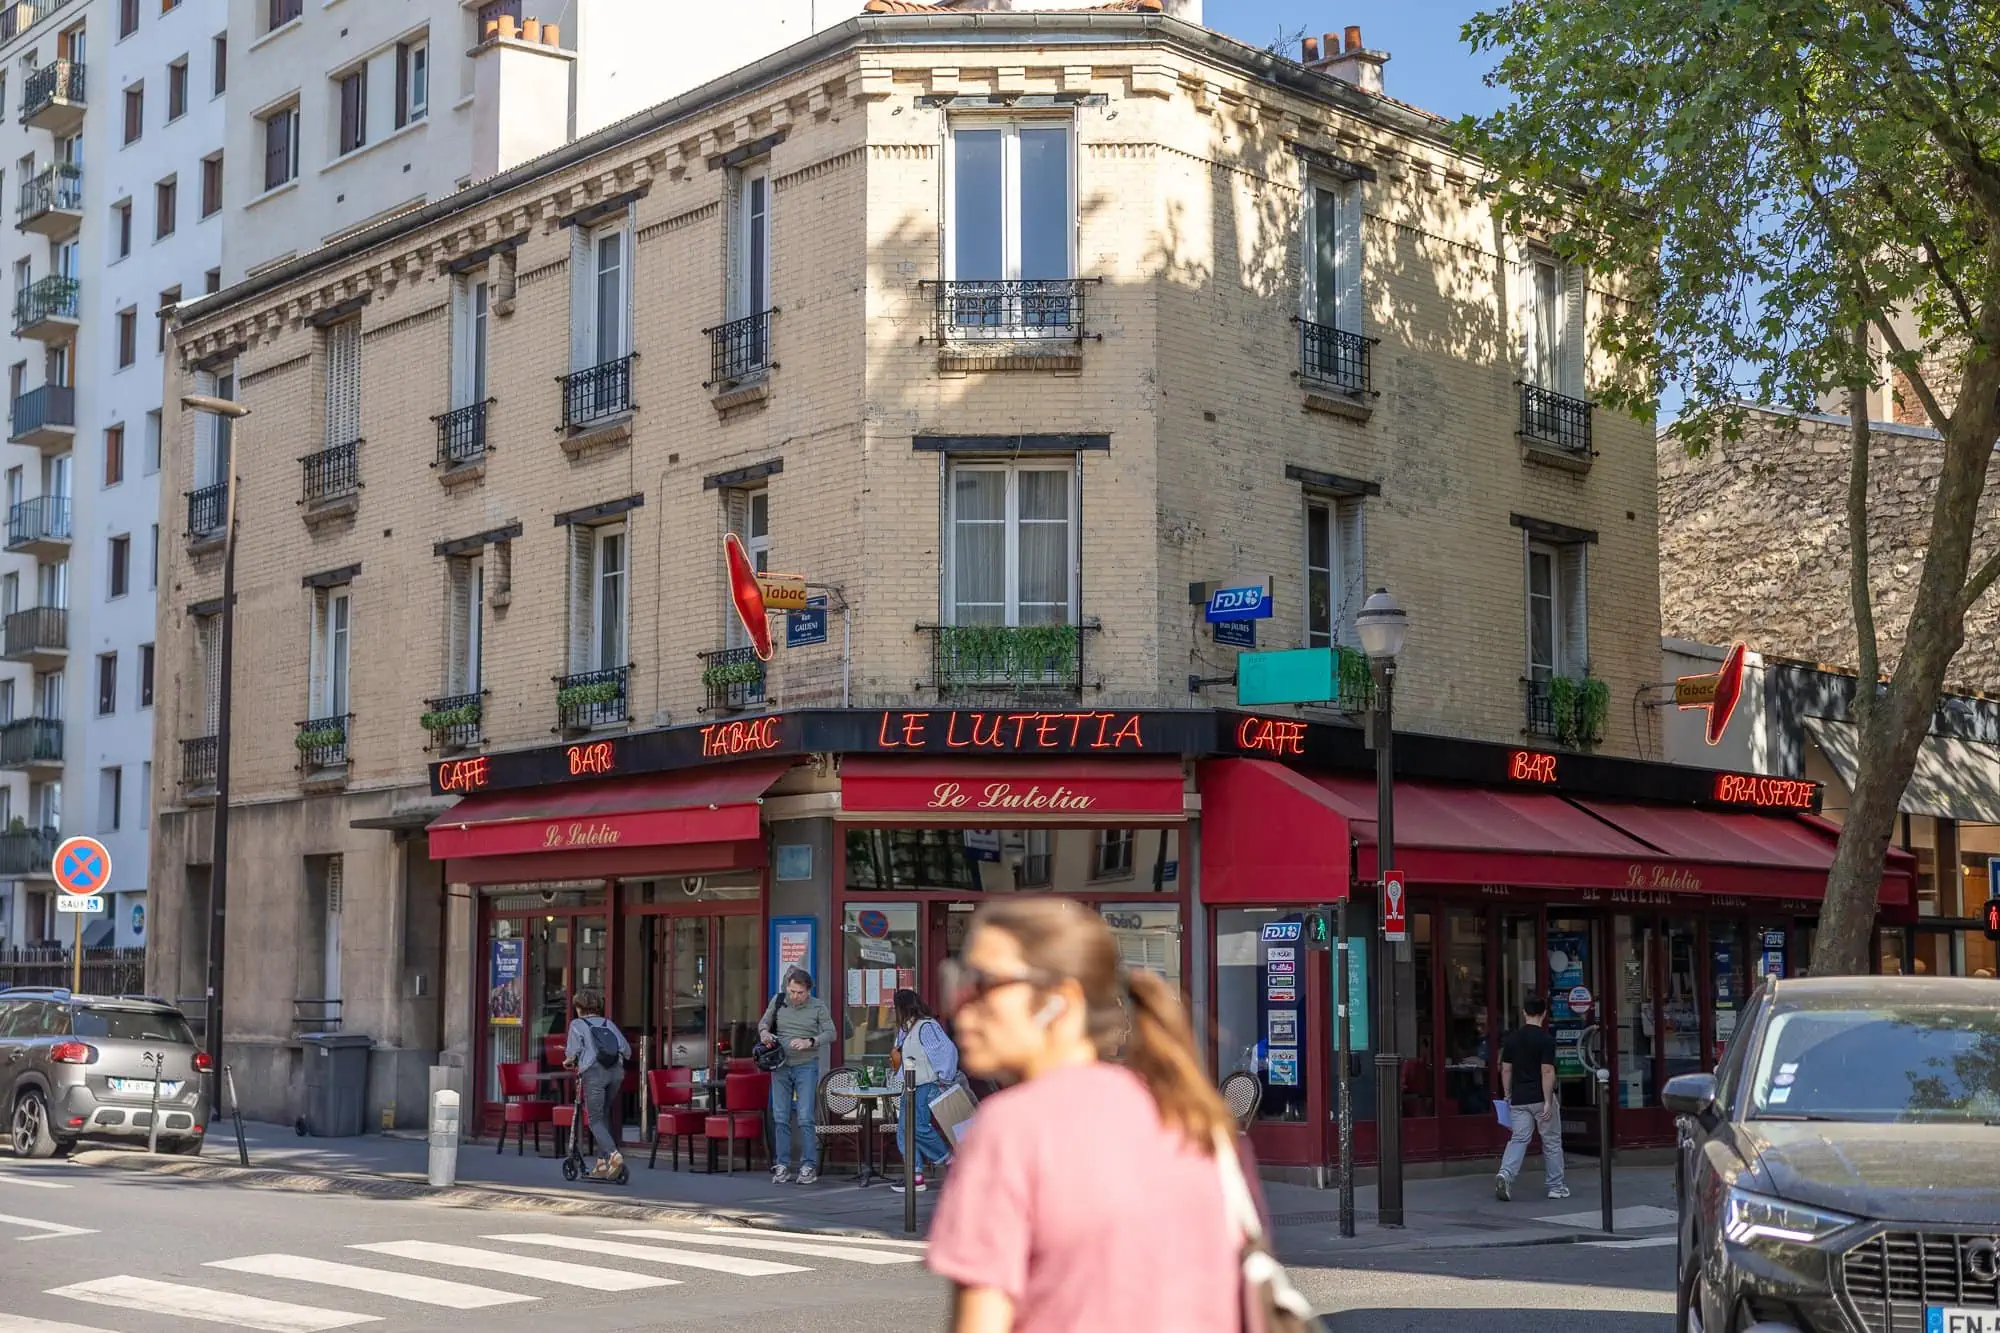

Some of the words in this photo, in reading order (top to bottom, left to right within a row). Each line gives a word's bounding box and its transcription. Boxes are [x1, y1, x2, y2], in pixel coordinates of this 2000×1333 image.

[763, 584, 805, 600] Tabac
[1214, 591, 1243, 608] FDJ
[1678, 684, 1714, 696] Tabac
[700, 716, 780, 756] TABAC
[879, 712, 929, 747] LE
[948, 711, 1143, 748] LUTETIA
[1241, 717, 1308, 755] CAFE
[567, 742, 614, 775] BAR
[1511, 751, 1557, 783] BAR
[439, 757, 486, 791] CAFE
[928, 782, 971, 809] Le
[977, 782, 1096, 809] Lutetia
[1719, 775, 1817, 808] BRASSERIE
[543, 824, 563, 848] Le
[566, 822, 621, 846] Lutetia
[1627, 863, 1647, 887] Le
[1650, 864, 1703, 891] Lutetia
[60, 900, 84, 908] SAUF
[1265, 926, 1286, 938] FDJ
[1950, 1315, 2000, 1333] EN-
